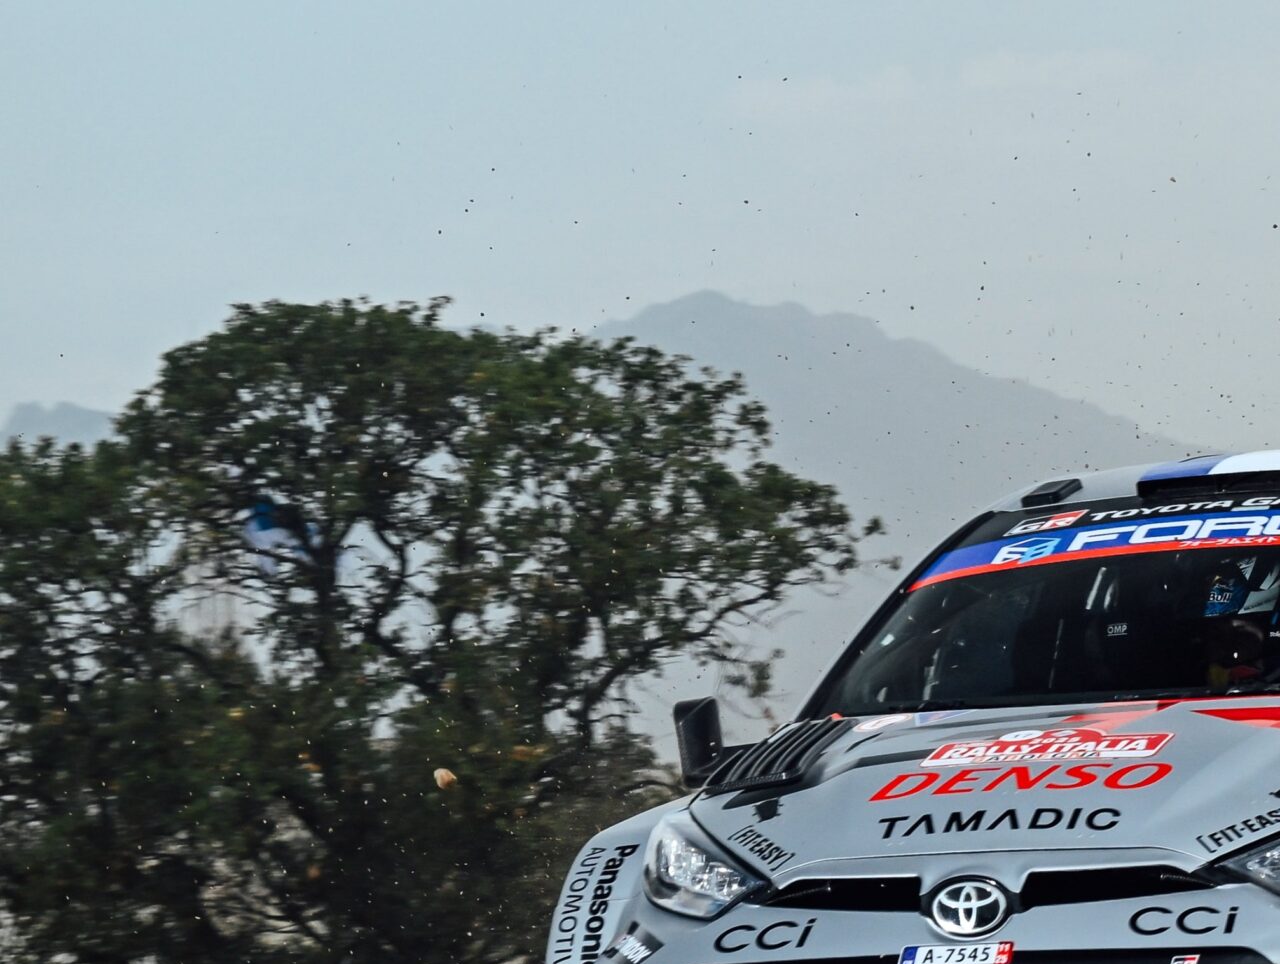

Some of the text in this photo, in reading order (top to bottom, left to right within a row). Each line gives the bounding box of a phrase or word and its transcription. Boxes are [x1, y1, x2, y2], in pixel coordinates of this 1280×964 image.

[1090, 500, 1234, 521] TOYOTA
[1107, 625, 1127, 634] OMP
[943, 744, 1042, 759] RALLY
[1047, 739, 1149, 753] ITALIA
[869, 762, 1174, 801] DENSO
[878, 808, 1121, 839] TAMADIC
[921, 947, 991, 964] A-7545
